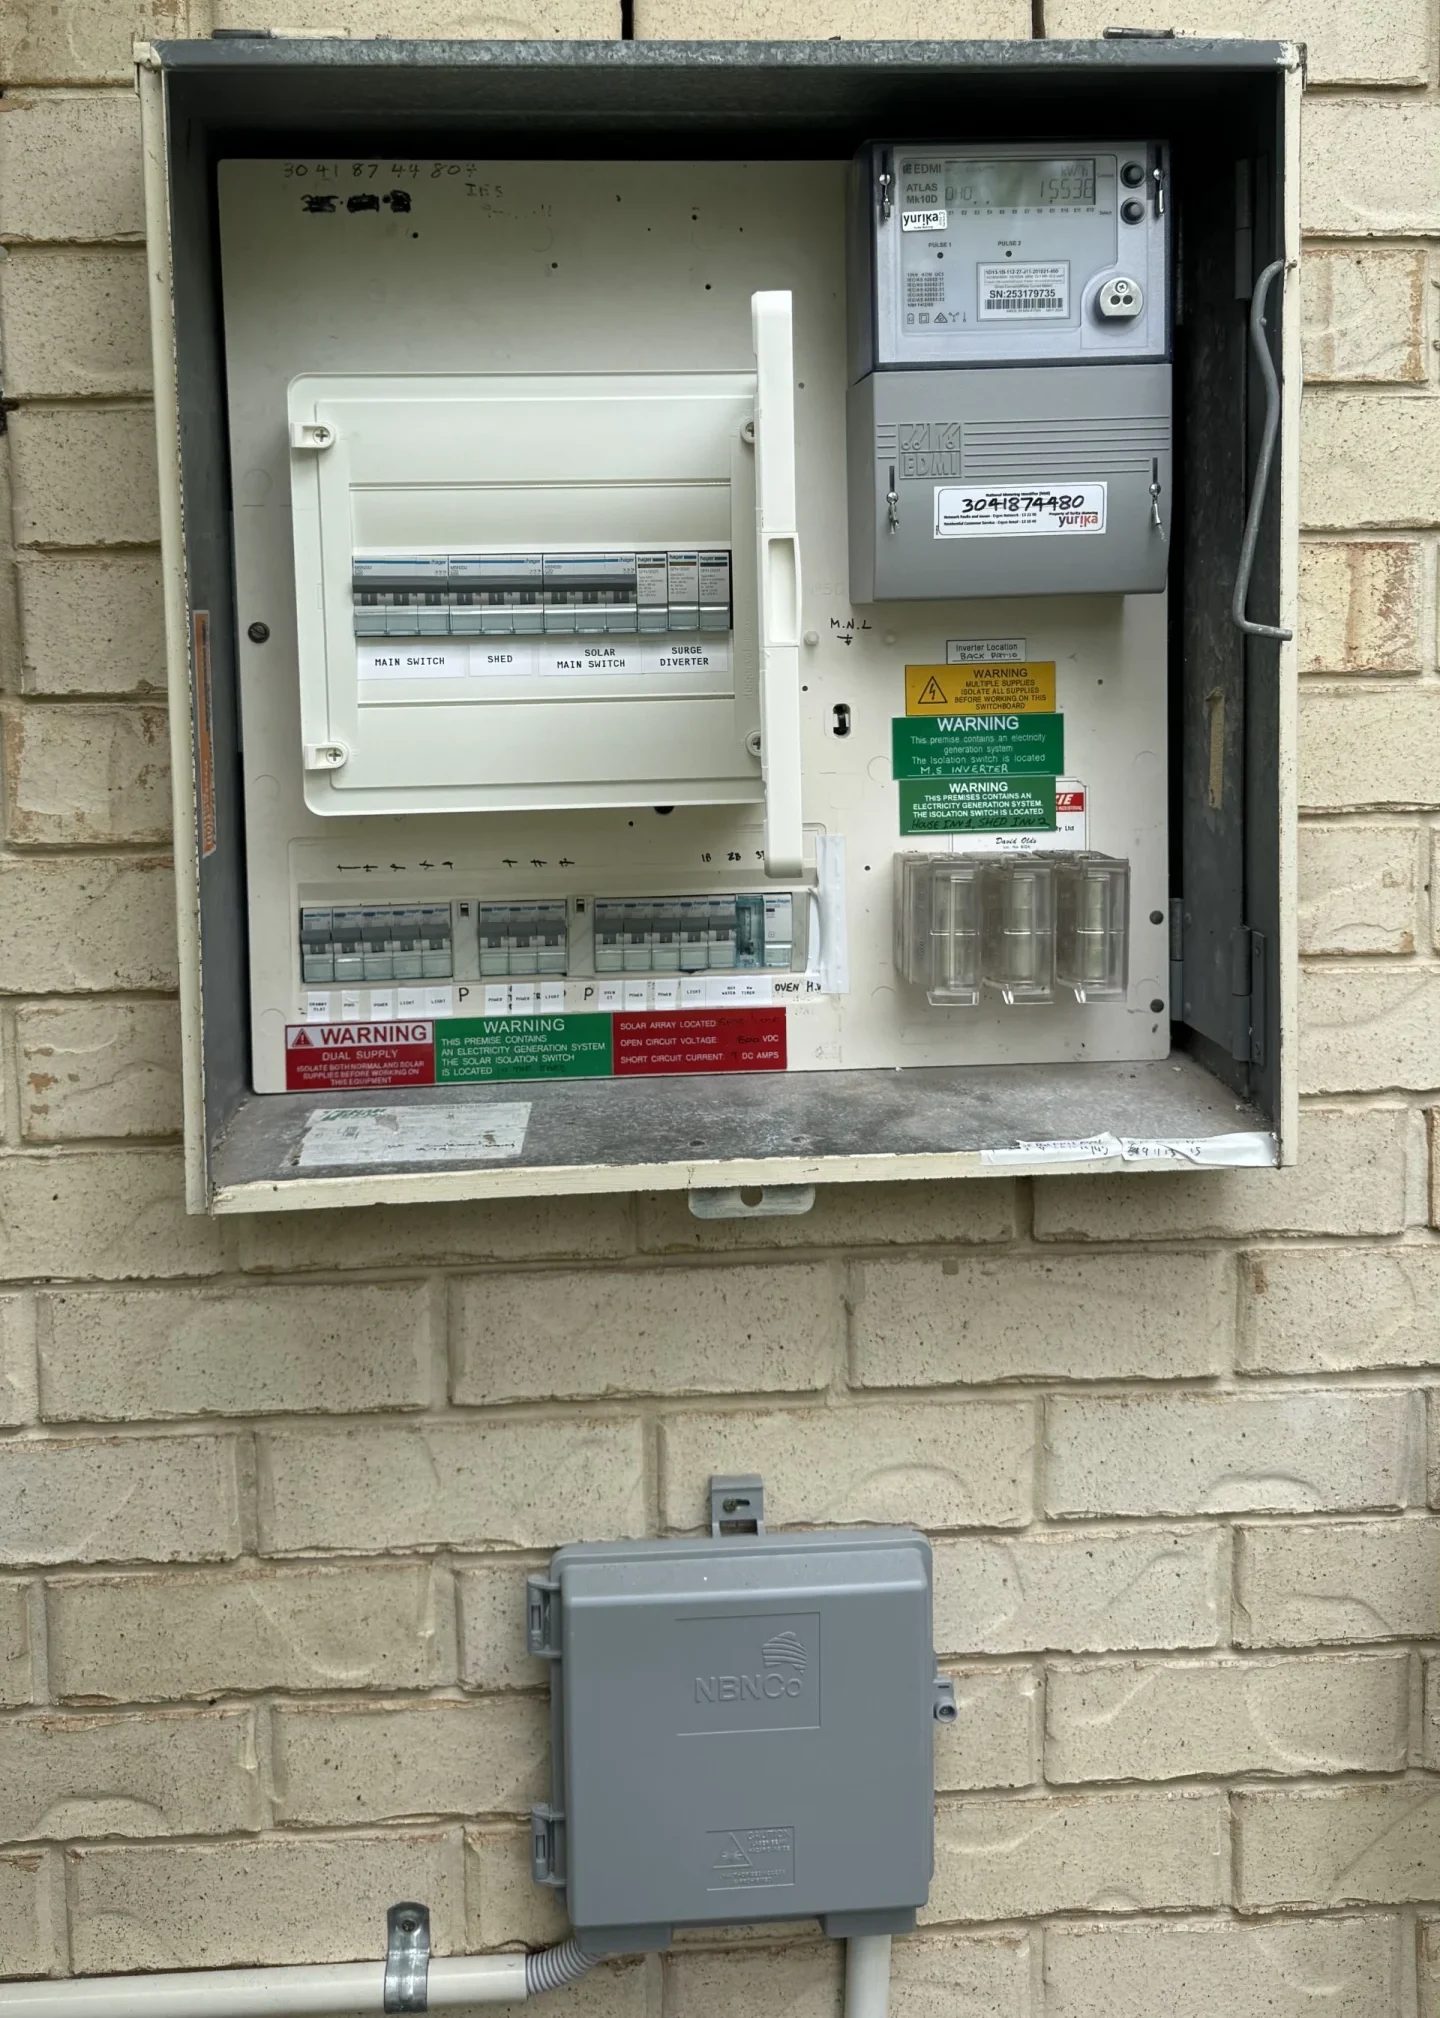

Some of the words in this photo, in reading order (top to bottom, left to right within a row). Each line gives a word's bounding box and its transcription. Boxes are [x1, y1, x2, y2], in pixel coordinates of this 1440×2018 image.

[913, 163, 942, 174] EDMI
[906, 183, 938, 192] ATLAS
[906, 195, 938, 204] Mk10D
[903, 213, 939, 227] yurika
[989, 289, 1056, 299] SN:253179735
[904, 454, 959, 477] EDMI
[962, 494, 1084, 513] 3041874480
[1058, 515, 1098, 528] yurika
[671, 646, 702, 655] SURGE
[956, 644, 984, 652] Inverter
[987, 643, 1018, 651] Location
[584, 649, 616, 657] SOLAR
[375, 658, 400, 666] MAIN
[407, 657, 445, 666] SWITCH
[487, 655, 513, 663] SHED
[557, 660, 582, 669] MAIN
[588, 659, 625, 668] SWITCH
[660, 657, 709, 666] DIVERTER
[973, 668, 1028, 678] WARNING
[937, 716, 1019, 732] WARNING
[910, 736, 927, 744] This
[930, 736, 960, 745] premise
[964, 734, 994, 743] contains
[1011, 733, 1046, 743] electricity
[944, 746, 983, 755] generation
[987, 745, 1013, 754] system
[912, 756, 926, 764] The
[971, 755, 997, 763] switch
[1014, 754, 1045, 763] located
[952, 764, 1009, 774] INVERTER
[949, 782, 1009, 793] WARNING
[913, 802, 960, 810] ELECTRICITY
[962, 801, 1010, 809] GENERATION
[1011, 800, 1043, 808] SYSTEM.
[929, 810, 968, 818] ISOLATION
[970, 809, 998, 817] SWITCH
[1009, 808, 1043, 816] LOCATED
[996, 837, 1016, 845] David
[774, 982, 800, 992] OVEN
[458, 987, 469, 1002] P
[584, 987, 594, 1001] P
[483, 1018, 565, 1034] WARNING
[620, 1022, 647, 1030] SOLAR
[650, 1021, 676, 1029] ARRAY
[320, 1025, 427, 1045] WARNING
[441, 1038, 461, 1046] THIS
[464, 1036, 501, 1045] PREMISE
[505, 1034, 547, 1043] CONTAINS
[763, 1034, 779, 1042] VDC
[620, 1039, 643, 1047] OPEN
[646, 1037, 676, 1046] CIRCUIT
[441, 1048, 454, 1056] AN
[457, 1046, 510, 1055] ELECTRICITY
[514, 1044, 567, 1053] GENERATION
[571, 1042, 606, 1051] SYSTEM
[322, 1051, 351, 1061] DUAL
[356, 1049, 399, 1060] SUPPLY
[442, 1058, 459, 1066] THE
[462, 1056, 491, 1065] SOLAR
[495, 1054, 538, 1063] ISOLATION
[542, 1053, 575, 1062] SWITCH
[620, 1056, 647, 1064] SHORT
[651, 1054, 682, 1062] CIRCUIT
[742, 1052, 753, 1060] DC
[757, 1051, 779, 1059] AMPS
[296, 1064, 328, 1072] ISOLATE
[350, 1062, 383, 1070] NORMAL
[400, 1060, 424, 1068] SOLAR
[303, 1071, 339, 1079] SUPPLIES
[341, 1070, 370, 1078] BEFORE
[442, 1068, 450, 1076] IS
[453, 1067, 492, 1076] LOCATED
[331, 1078, 348, 1086] THIS
[349, 1077, 392, 1085] EQUIPMENT
[694, 1673, 803, 1704] NBNCo
